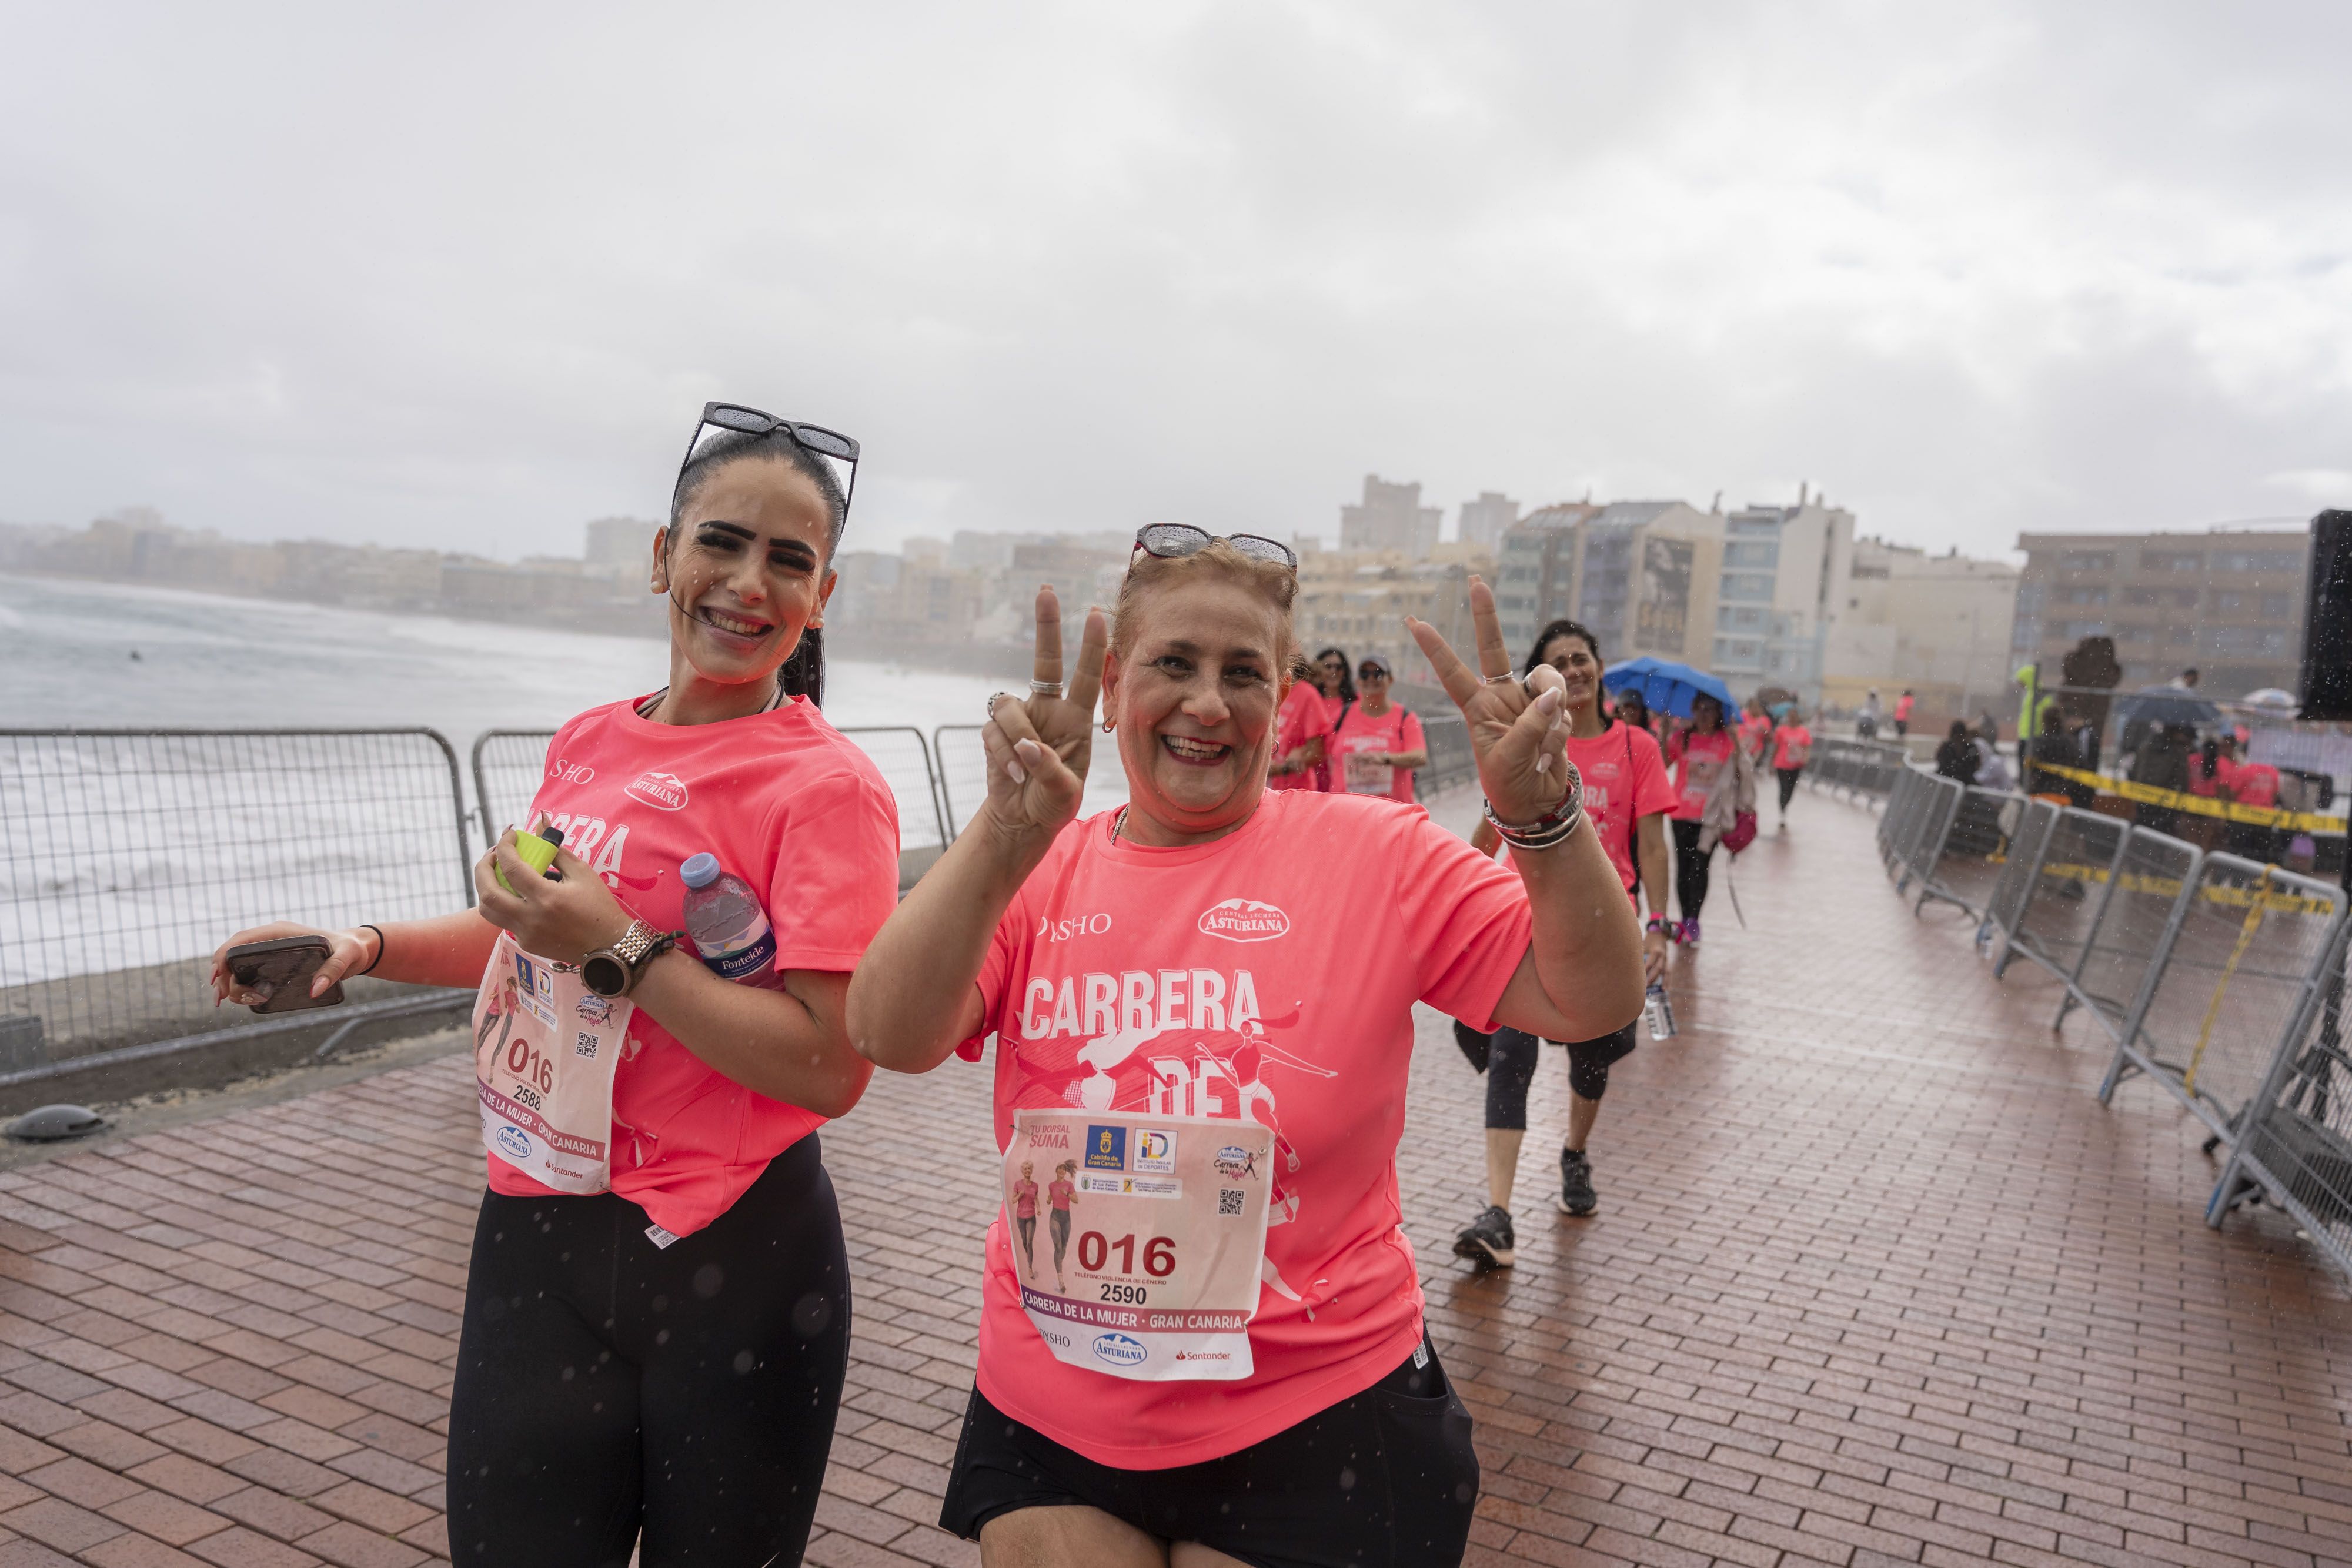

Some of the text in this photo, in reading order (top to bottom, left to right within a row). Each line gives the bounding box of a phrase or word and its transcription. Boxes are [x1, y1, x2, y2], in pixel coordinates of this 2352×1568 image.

[629, 777, 679, 807] ASTURIANA
[1205, 914, 1284, 931] ASTURIANA
[1219, 911, 1248, 919] CENTRAL
[721, 945, 764, 970] Fonteide
[576, 1005, 598, 1016] Carrera
[582, 998, 605, 1008] ASTURIANA
[1021, 969, 1264, 1040] CARRERA
[586, 1015, 603, 1027] Mujer
[502, 1069, 519, 1081] TELÉFONO
[508, 1038, 553, 1094] 016
[1148, 1055, 1231, 1117] DE
[513, 1085, 540, 1111] 2588
[487, 1093, 495, 1107] DE
[496, 1098, 505, 1113] LA
[506, 1104, 532, 1127] MUJER
[538, 1122, 552, 1142] GRAN
[552, 1134, 597, 1156] CANARIA
[1041, 1125, 1070, 1134] DORSAL
[499, 1131, 528, 1155] ASTURIANA
[1029, 1134, 1069, 1149] SUMA
[551, 1164, 583, 1179] Santander
[1214, 1159, 1239, 1169] Carrera
[1228, 1168, 1246, 1181] Mujer
[1078, 1231, 1176, 1277] 016
[1074, 1272, 1101, 1280] TELÉFONO
[1100, 1283, 1147, 1305] 2590
[1025, 1291, 1242, 1329] CARRERA DE LA MUJER GRAN CANARIA
[1039, 1328, 1070, 1348] OYSHO
[1097, 1341, 1142, 1360] ASTURIANA
[1187, 1352, 1231, 1360] Santander
